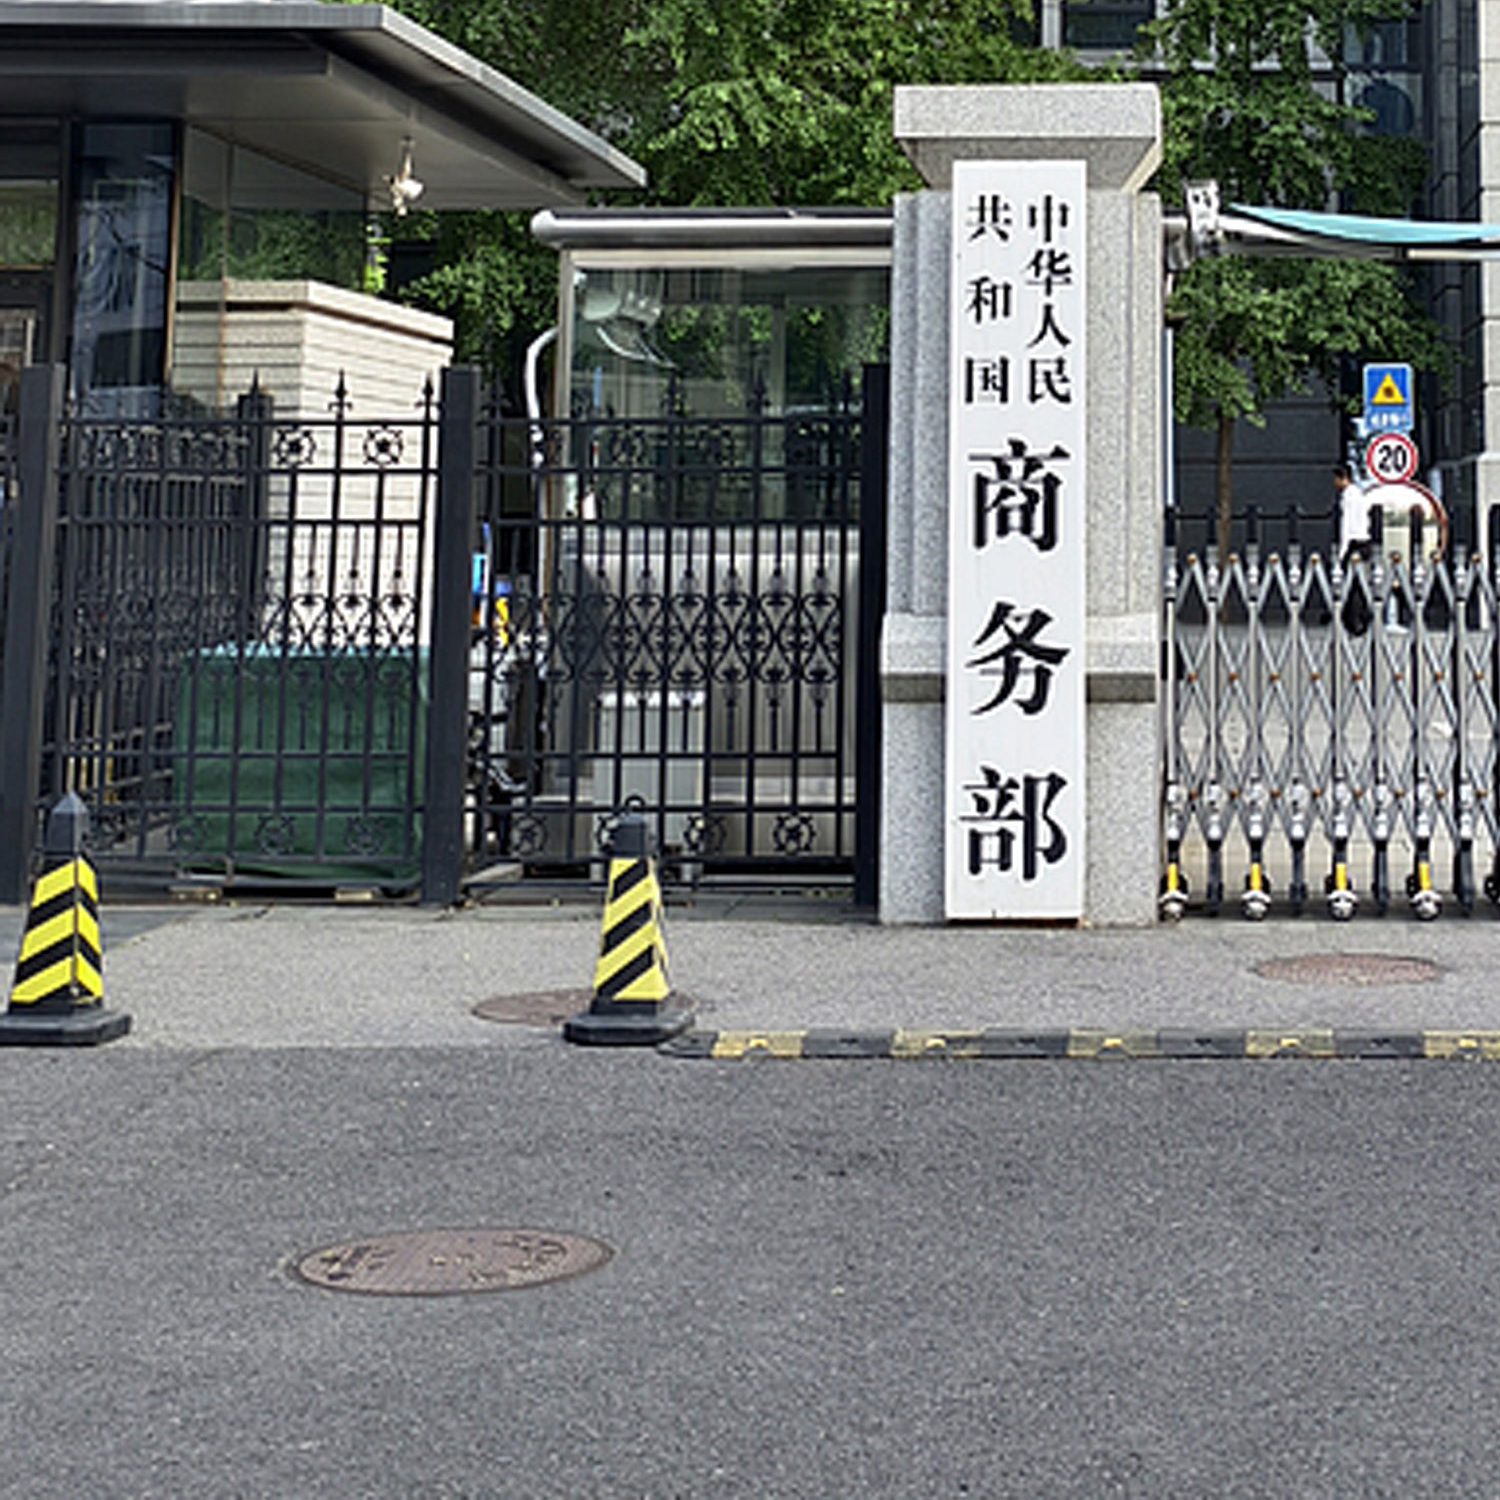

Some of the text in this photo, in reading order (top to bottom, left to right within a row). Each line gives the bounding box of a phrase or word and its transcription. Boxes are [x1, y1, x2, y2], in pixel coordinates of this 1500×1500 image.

[965, 195, 1012, 404] 共和国
[1028, 195, 1071, 404] 中华人民
[1377, 445, 1407, 473] 20
[960, 439, 1070, 880] 商务部
